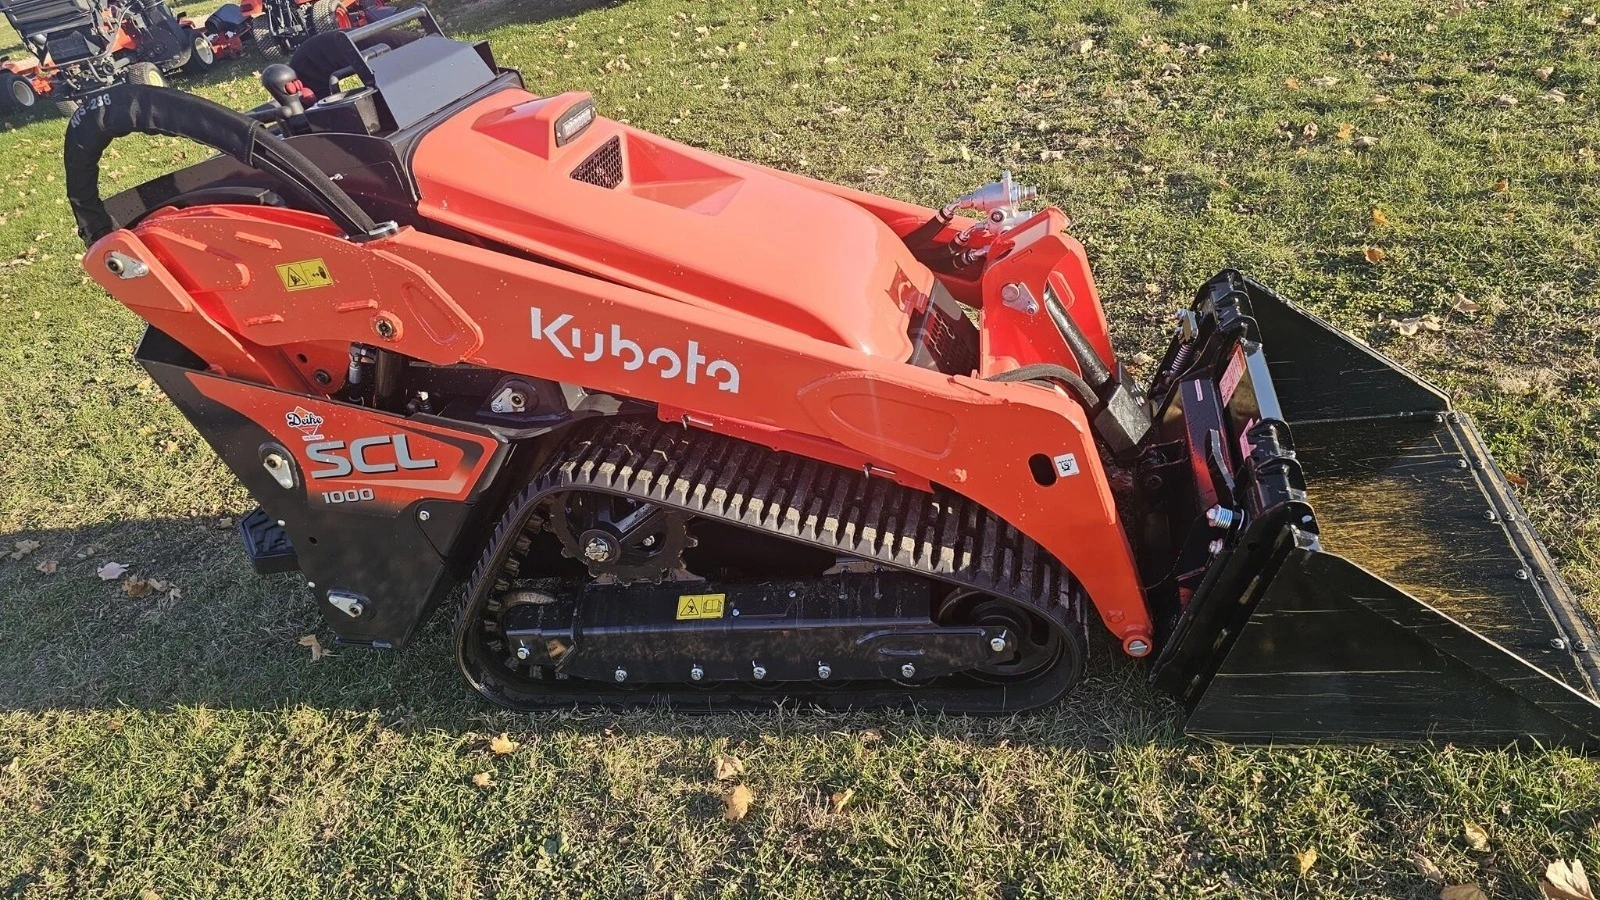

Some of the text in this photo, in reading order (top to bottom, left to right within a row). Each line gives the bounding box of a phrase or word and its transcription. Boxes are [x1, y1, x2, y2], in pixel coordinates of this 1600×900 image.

[530, 306, 740, 394] Kubota
[286, 412, 323, 426] Deike
[306, 433, 438, 480] SCL
[322, 488, 375, 504] 1000
